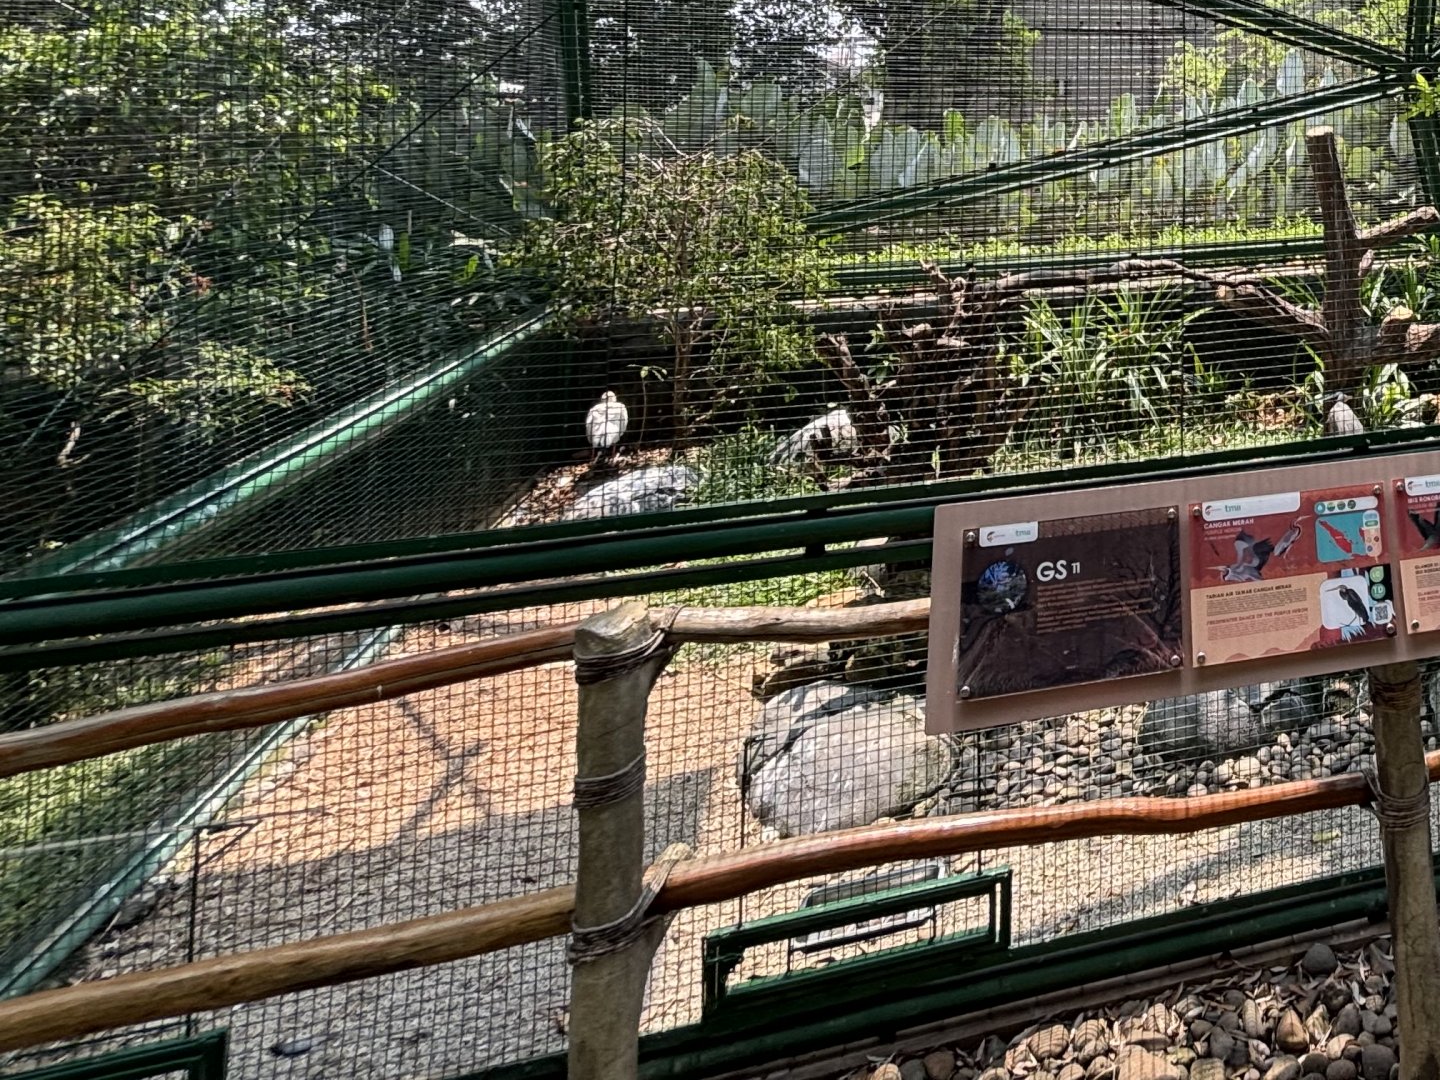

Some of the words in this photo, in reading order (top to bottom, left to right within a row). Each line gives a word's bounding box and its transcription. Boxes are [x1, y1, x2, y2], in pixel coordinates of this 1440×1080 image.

[1203, 520, 1231, 530] CANGAK
[1232, 518, 1254, 527] MERAH
[1036, 560, 1068, 582] GS
[1071, 561, 1081, 574] 11
